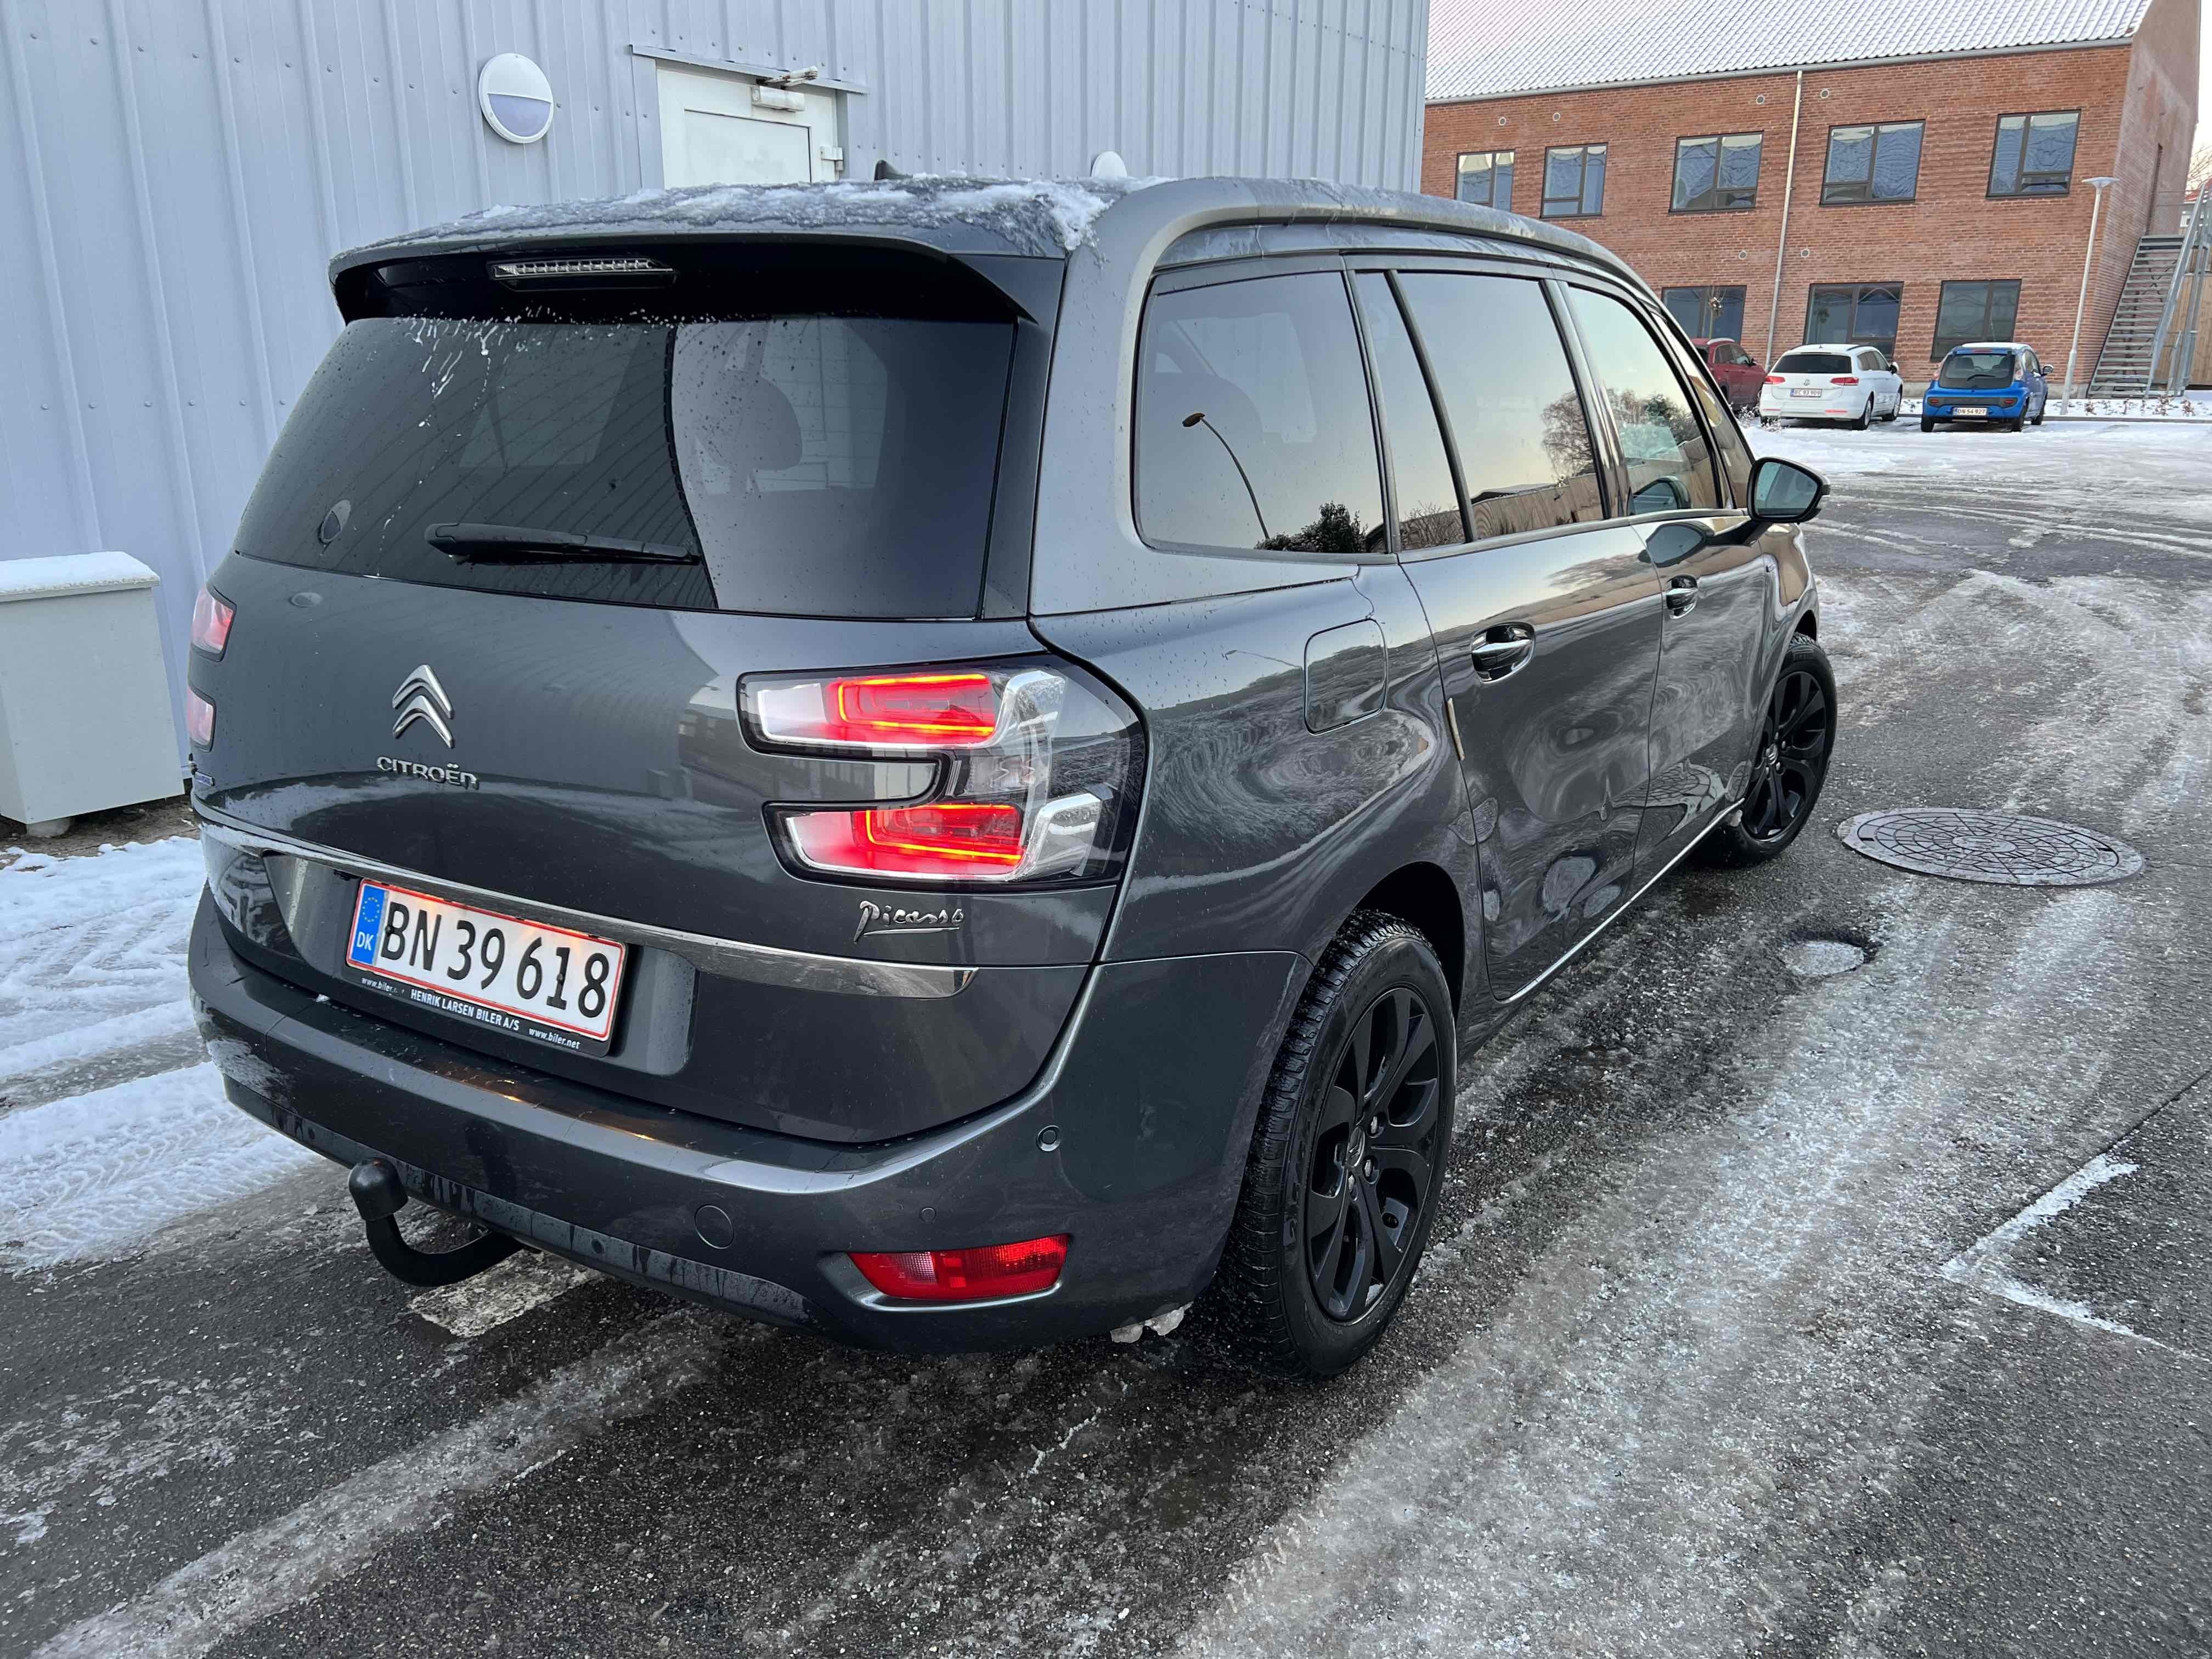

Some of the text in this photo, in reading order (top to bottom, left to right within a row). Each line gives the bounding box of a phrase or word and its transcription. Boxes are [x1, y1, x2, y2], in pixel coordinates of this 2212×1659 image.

[376, 756, 479, 791] CITROËN
[854, 900, 964, 944] Picasso
[357, 932, 373, 951] DK
[381, 901, 610, 1018] BN 39 618
[411, 989, 520, 1031] HENRIK LARSEN BILER A/S
[528, 1027, 580, 1049] www.biler.net
